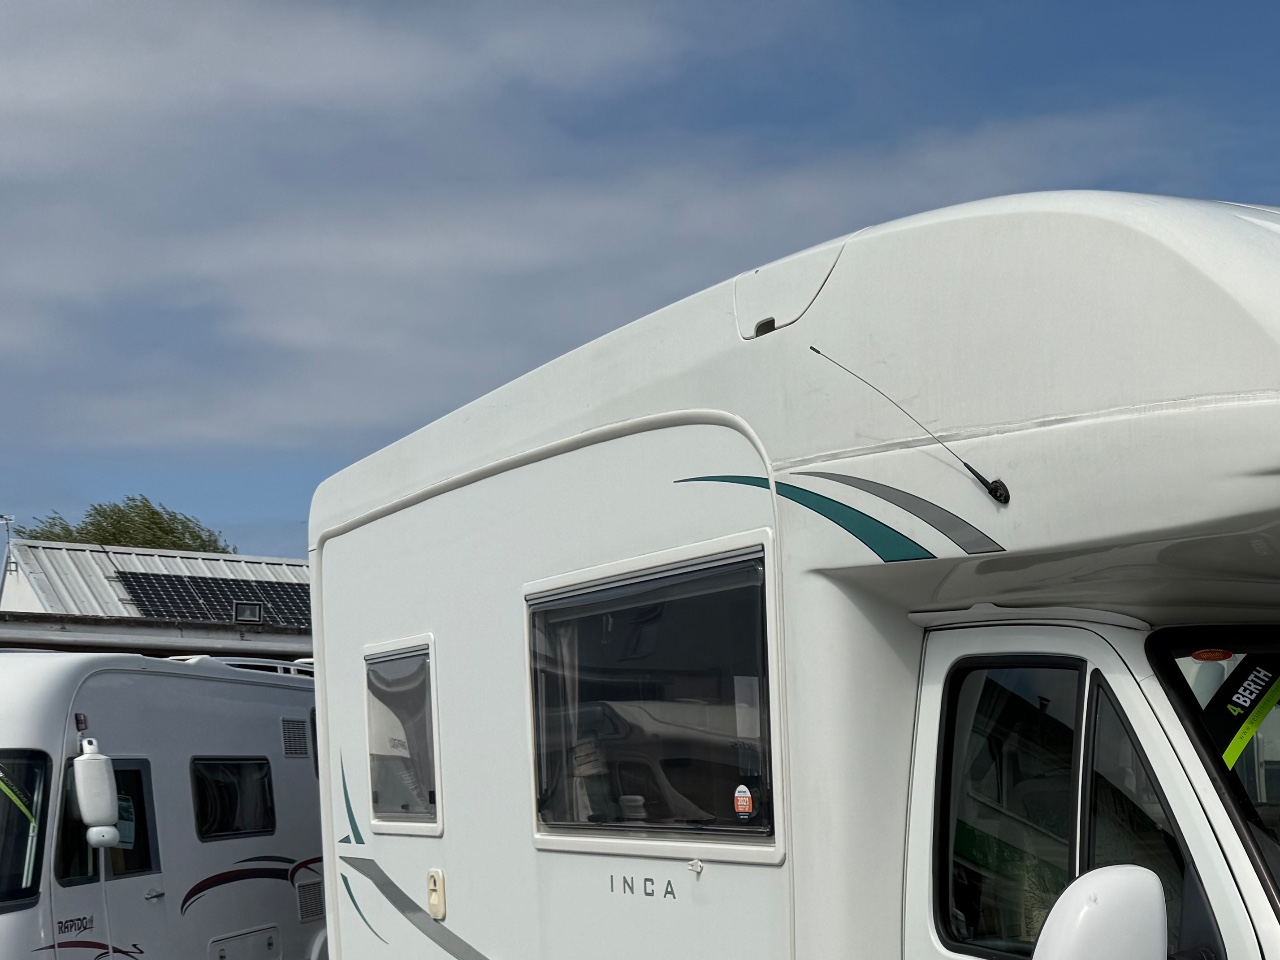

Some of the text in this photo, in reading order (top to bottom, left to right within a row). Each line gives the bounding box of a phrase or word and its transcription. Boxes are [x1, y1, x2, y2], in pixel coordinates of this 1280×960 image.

[1226, 666, 1273, 717] 4 BERTH
[611, 875, 676, 899] INCA
